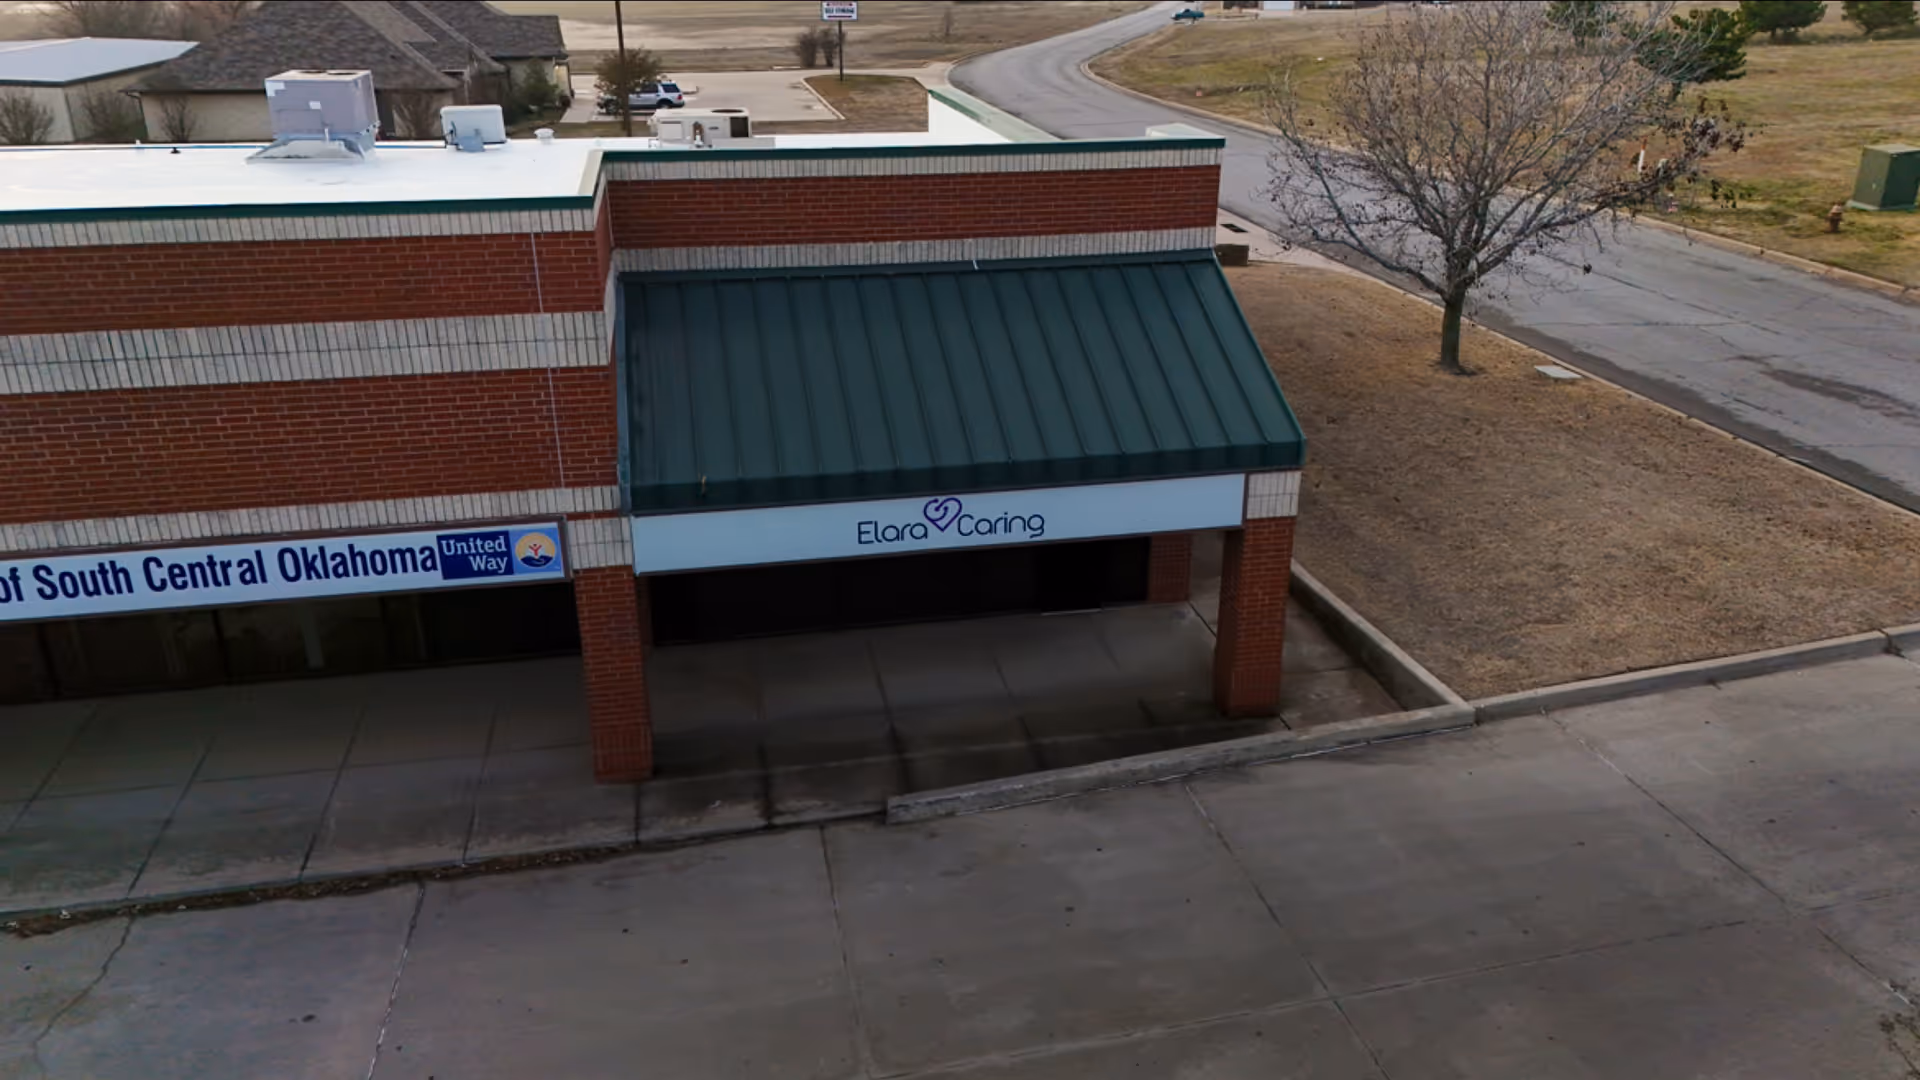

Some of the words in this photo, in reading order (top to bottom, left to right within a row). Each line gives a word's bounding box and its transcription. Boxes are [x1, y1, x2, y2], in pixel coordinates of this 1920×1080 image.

[857, 520, 928, 544] Elara
[957, 511, 1045, 538] Caring
[440, 535, 507, 555] United
[32, 560, 134, 600] South
[143, 549, 268, 592] Central
[277, 542, 438, 583] Oklahoma
[468, 555, 508, 574] Way
